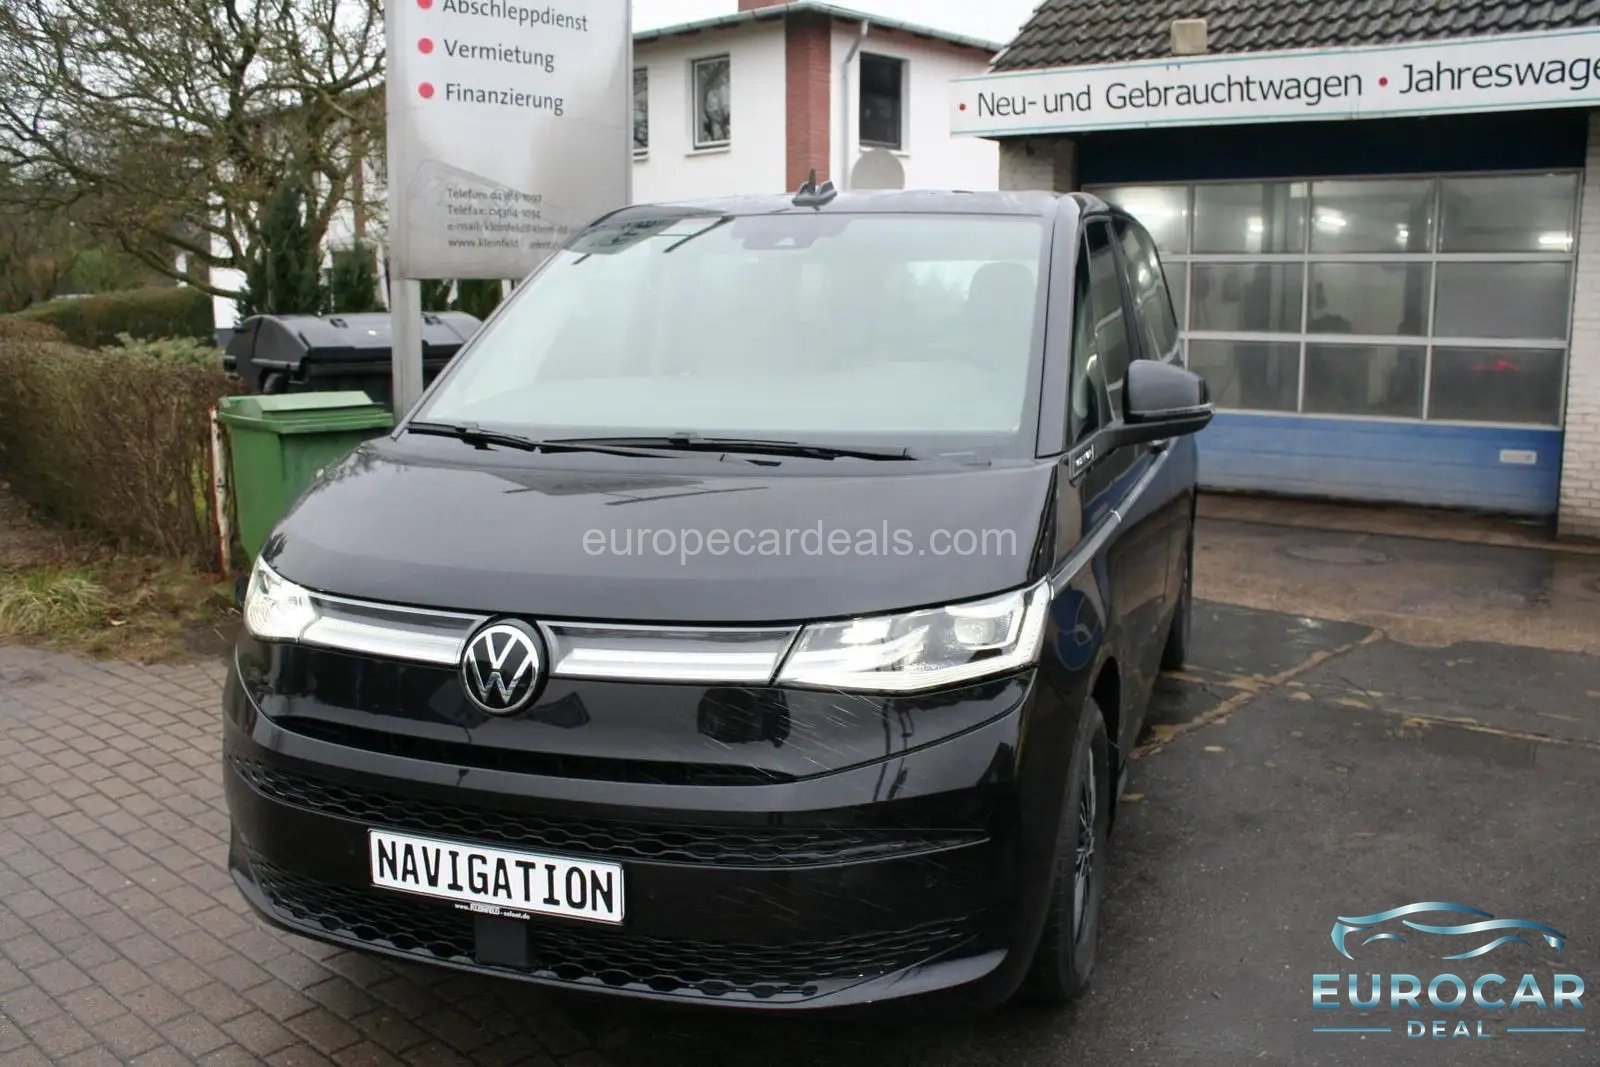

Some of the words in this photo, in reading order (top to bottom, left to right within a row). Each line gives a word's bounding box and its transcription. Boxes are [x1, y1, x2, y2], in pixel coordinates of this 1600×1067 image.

[443, 0, 588, 32] Abschleppdienst
[444, 39, 555, 73] Vermietung
[446, 83, 564, 117] Finanzierung
[1043, 85, 1092, 113] und
[1105, 73, 1363, 109] Gebrauchtwagen
[465, 627, 537, 709] VW
[377, 838, 613, 913] NAVIGATION
